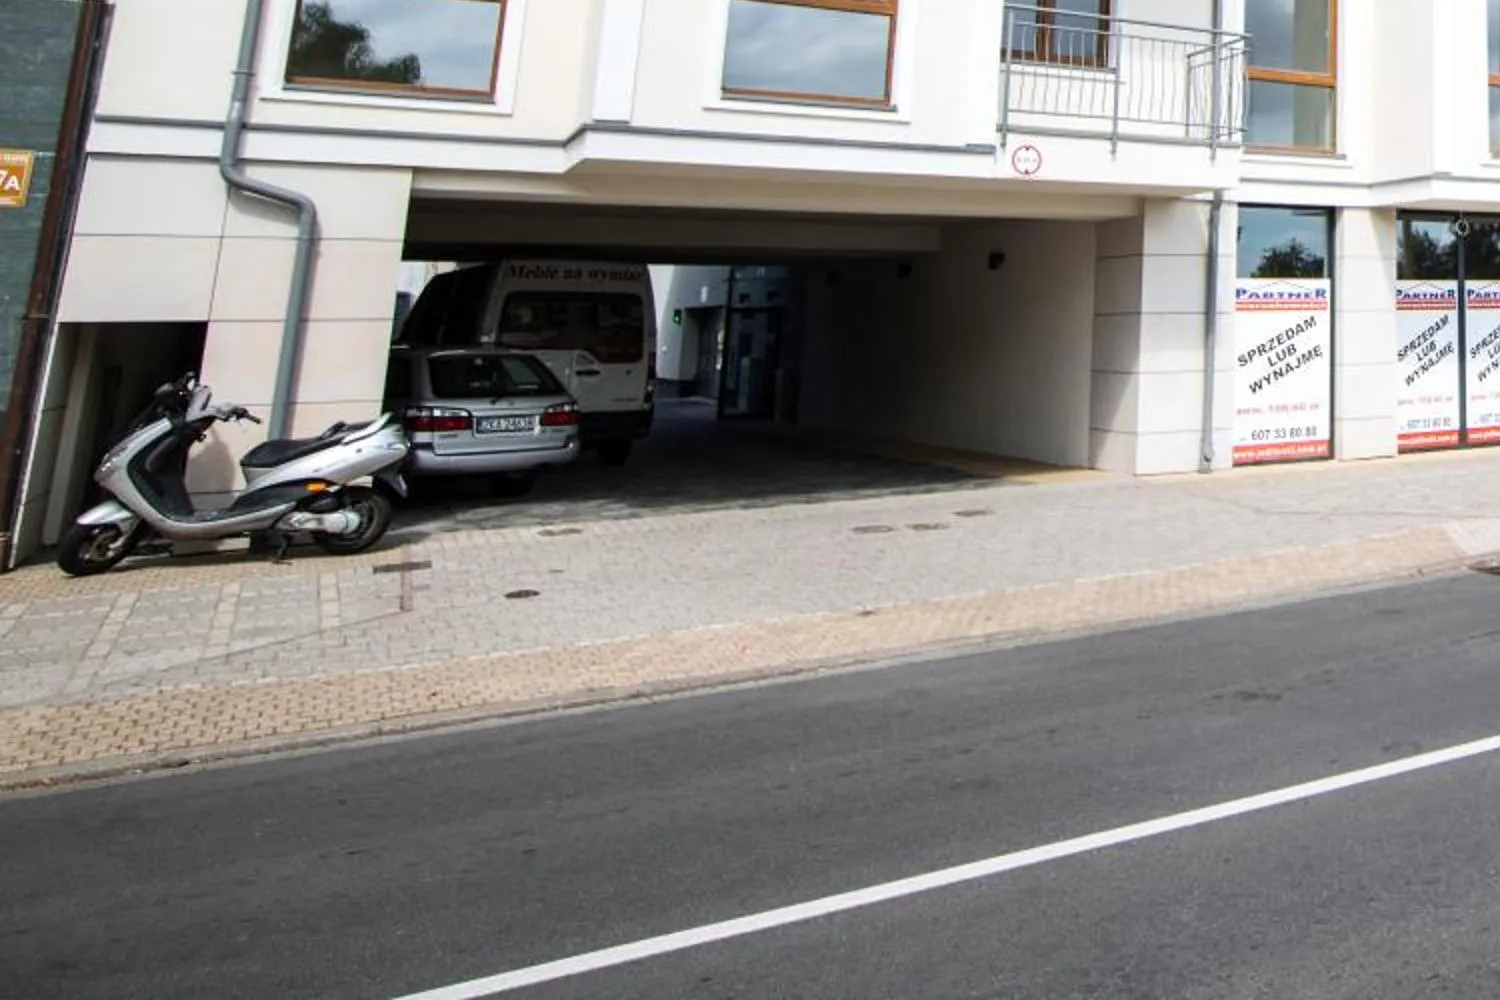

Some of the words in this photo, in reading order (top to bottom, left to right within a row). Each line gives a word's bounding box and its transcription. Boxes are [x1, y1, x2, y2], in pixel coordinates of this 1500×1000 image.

[1235, 287, 1328, 300] PARTNER
[1396, 288, 1456, 300] PARTNER
[1237, 315, 1318, 368] SPRZEDAM
[1398, 314, 1450, 362] SPRZEDAM
[1416, 340, 1437, 362] LUB
[1266, 342, 1298, 368] LUB
[1248, 343, 1324, 395] WYNAJMĘ
